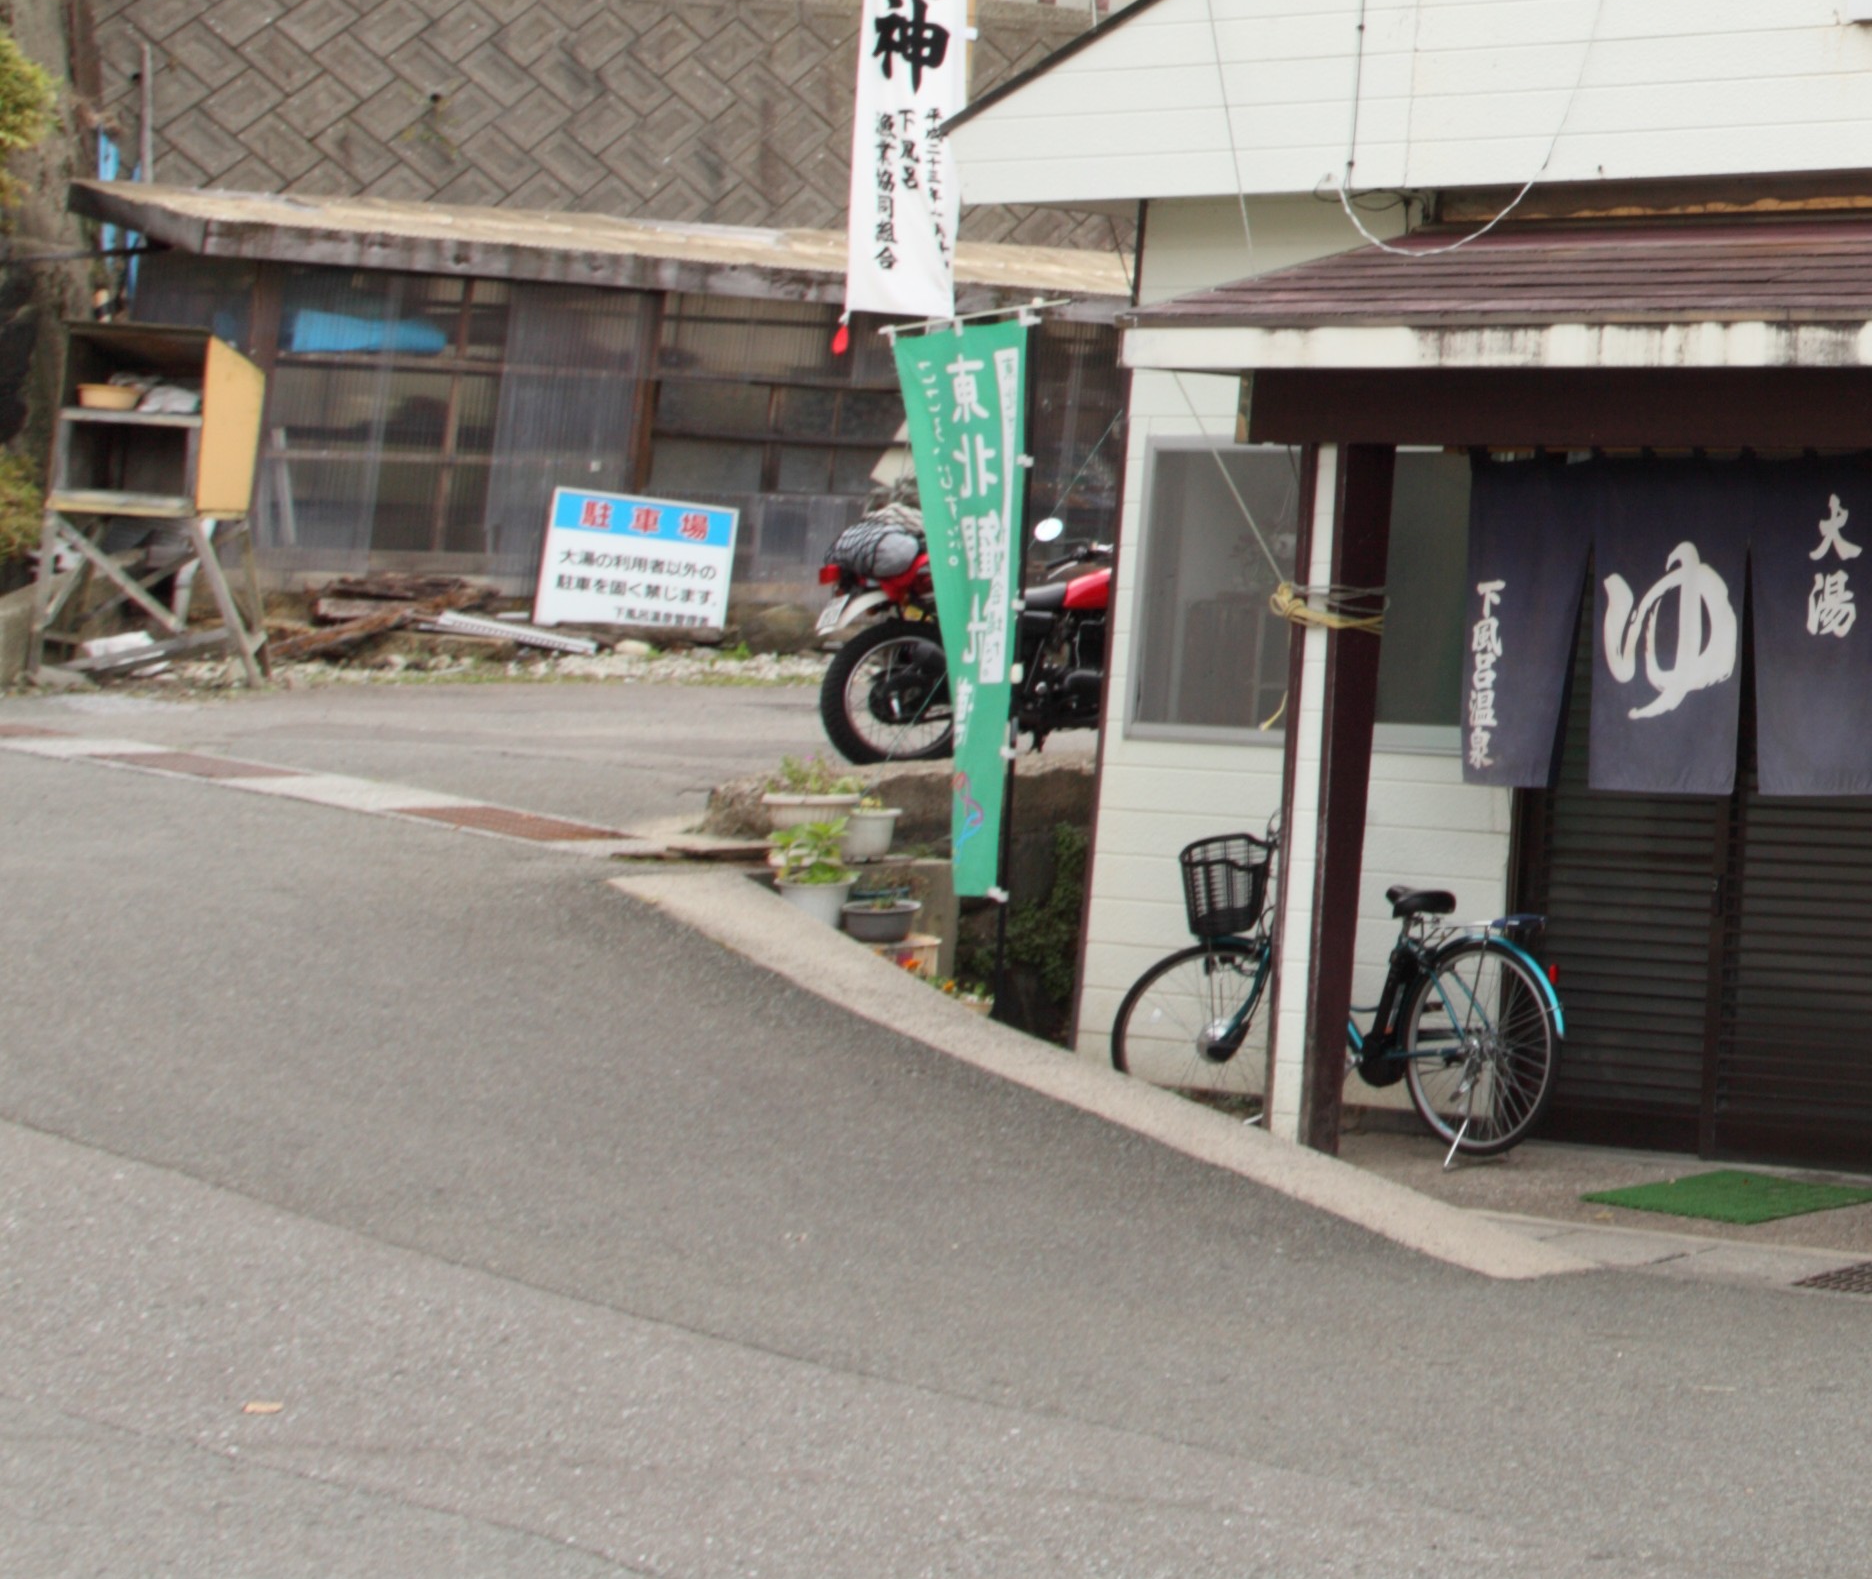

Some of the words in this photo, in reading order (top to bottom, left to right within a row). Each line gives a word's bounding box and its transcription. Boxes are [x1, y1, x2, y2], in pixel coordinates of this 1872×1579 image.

[898, 109, 920, 190] 下風呂
[559, 549, 717, 581] 大湯の利用者以外の
[580, 499, 709, 541] 駐車場
[1806, 493, 1862, 638] 大湯
[1469, 580, 1505, 768] 下風呂温泉
[1603, 541, 1738, 719] ゆ
